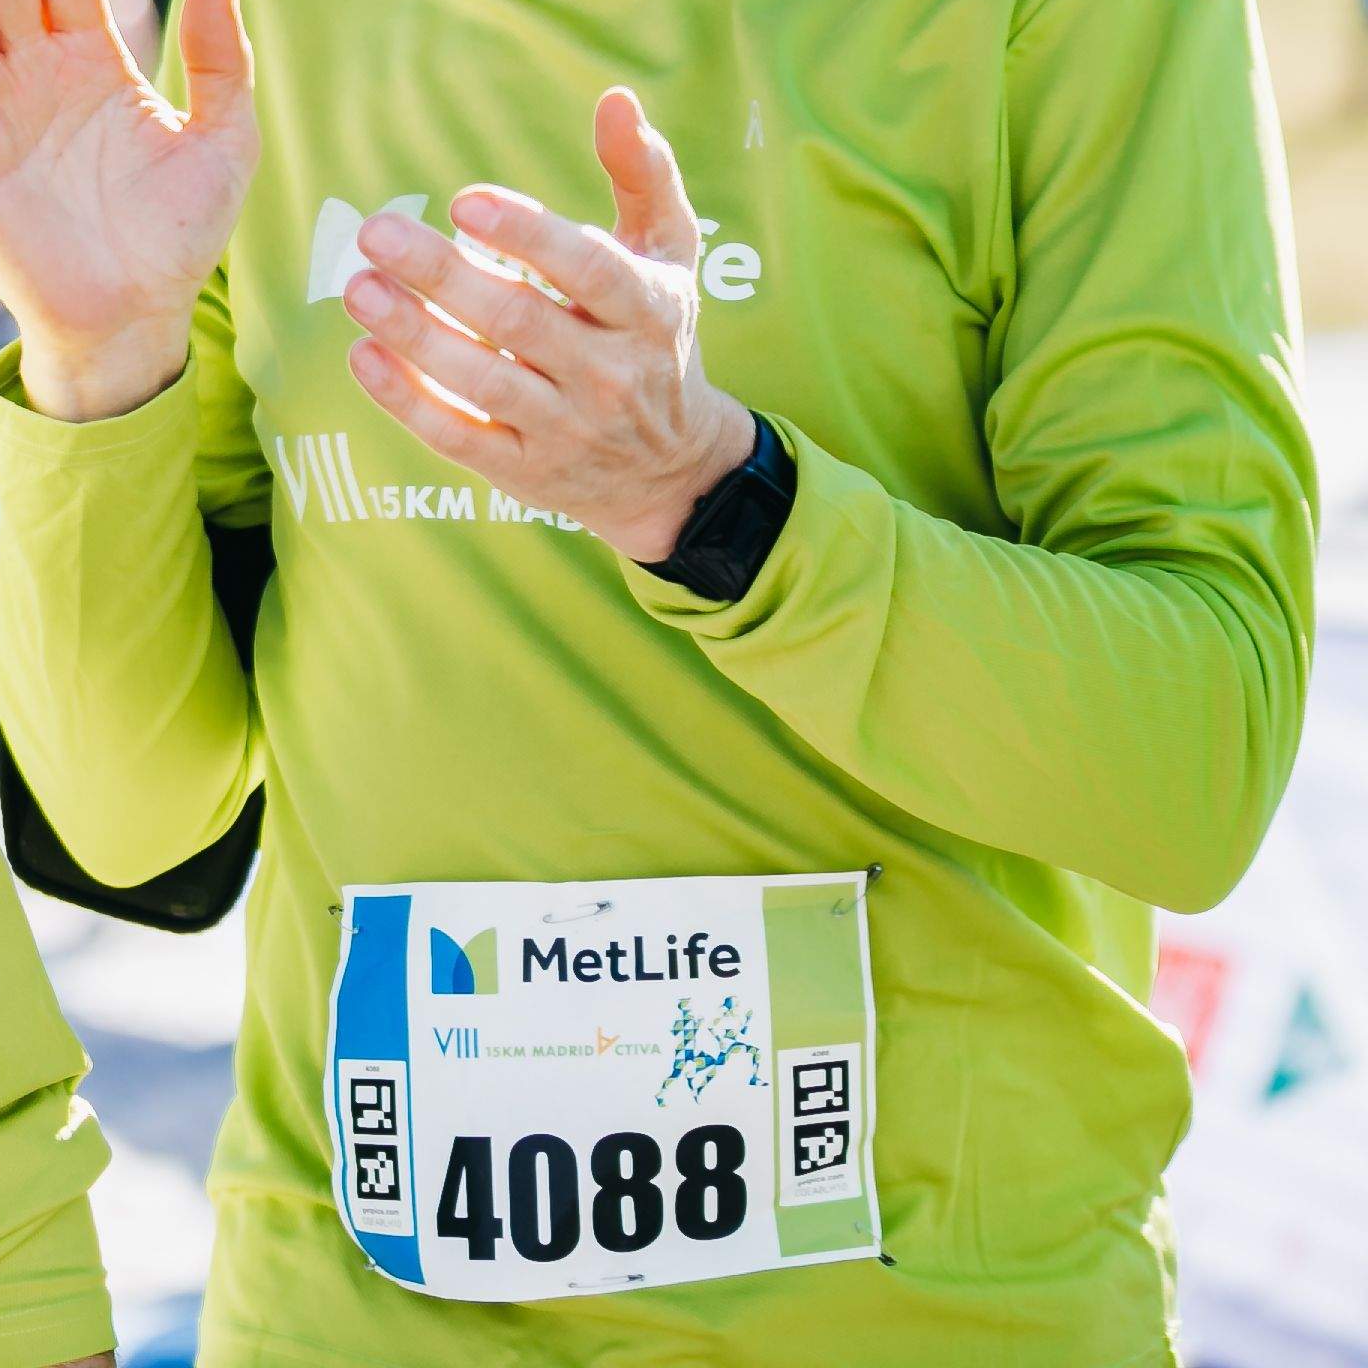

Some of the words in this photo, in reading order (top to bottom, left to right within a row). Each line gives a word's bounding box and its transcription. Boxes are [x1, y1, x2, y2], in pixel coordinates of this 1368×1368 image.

[276, 433, 368, 523] VIII
[367, 486, 476, 522] 15KM
[521, 932, 742, 984] MetLife
[433, 1027, 479, 1058] VIII
[532, 1044, 594, 1057] MADRID
[437, 1125, 749, 1264] 4088
